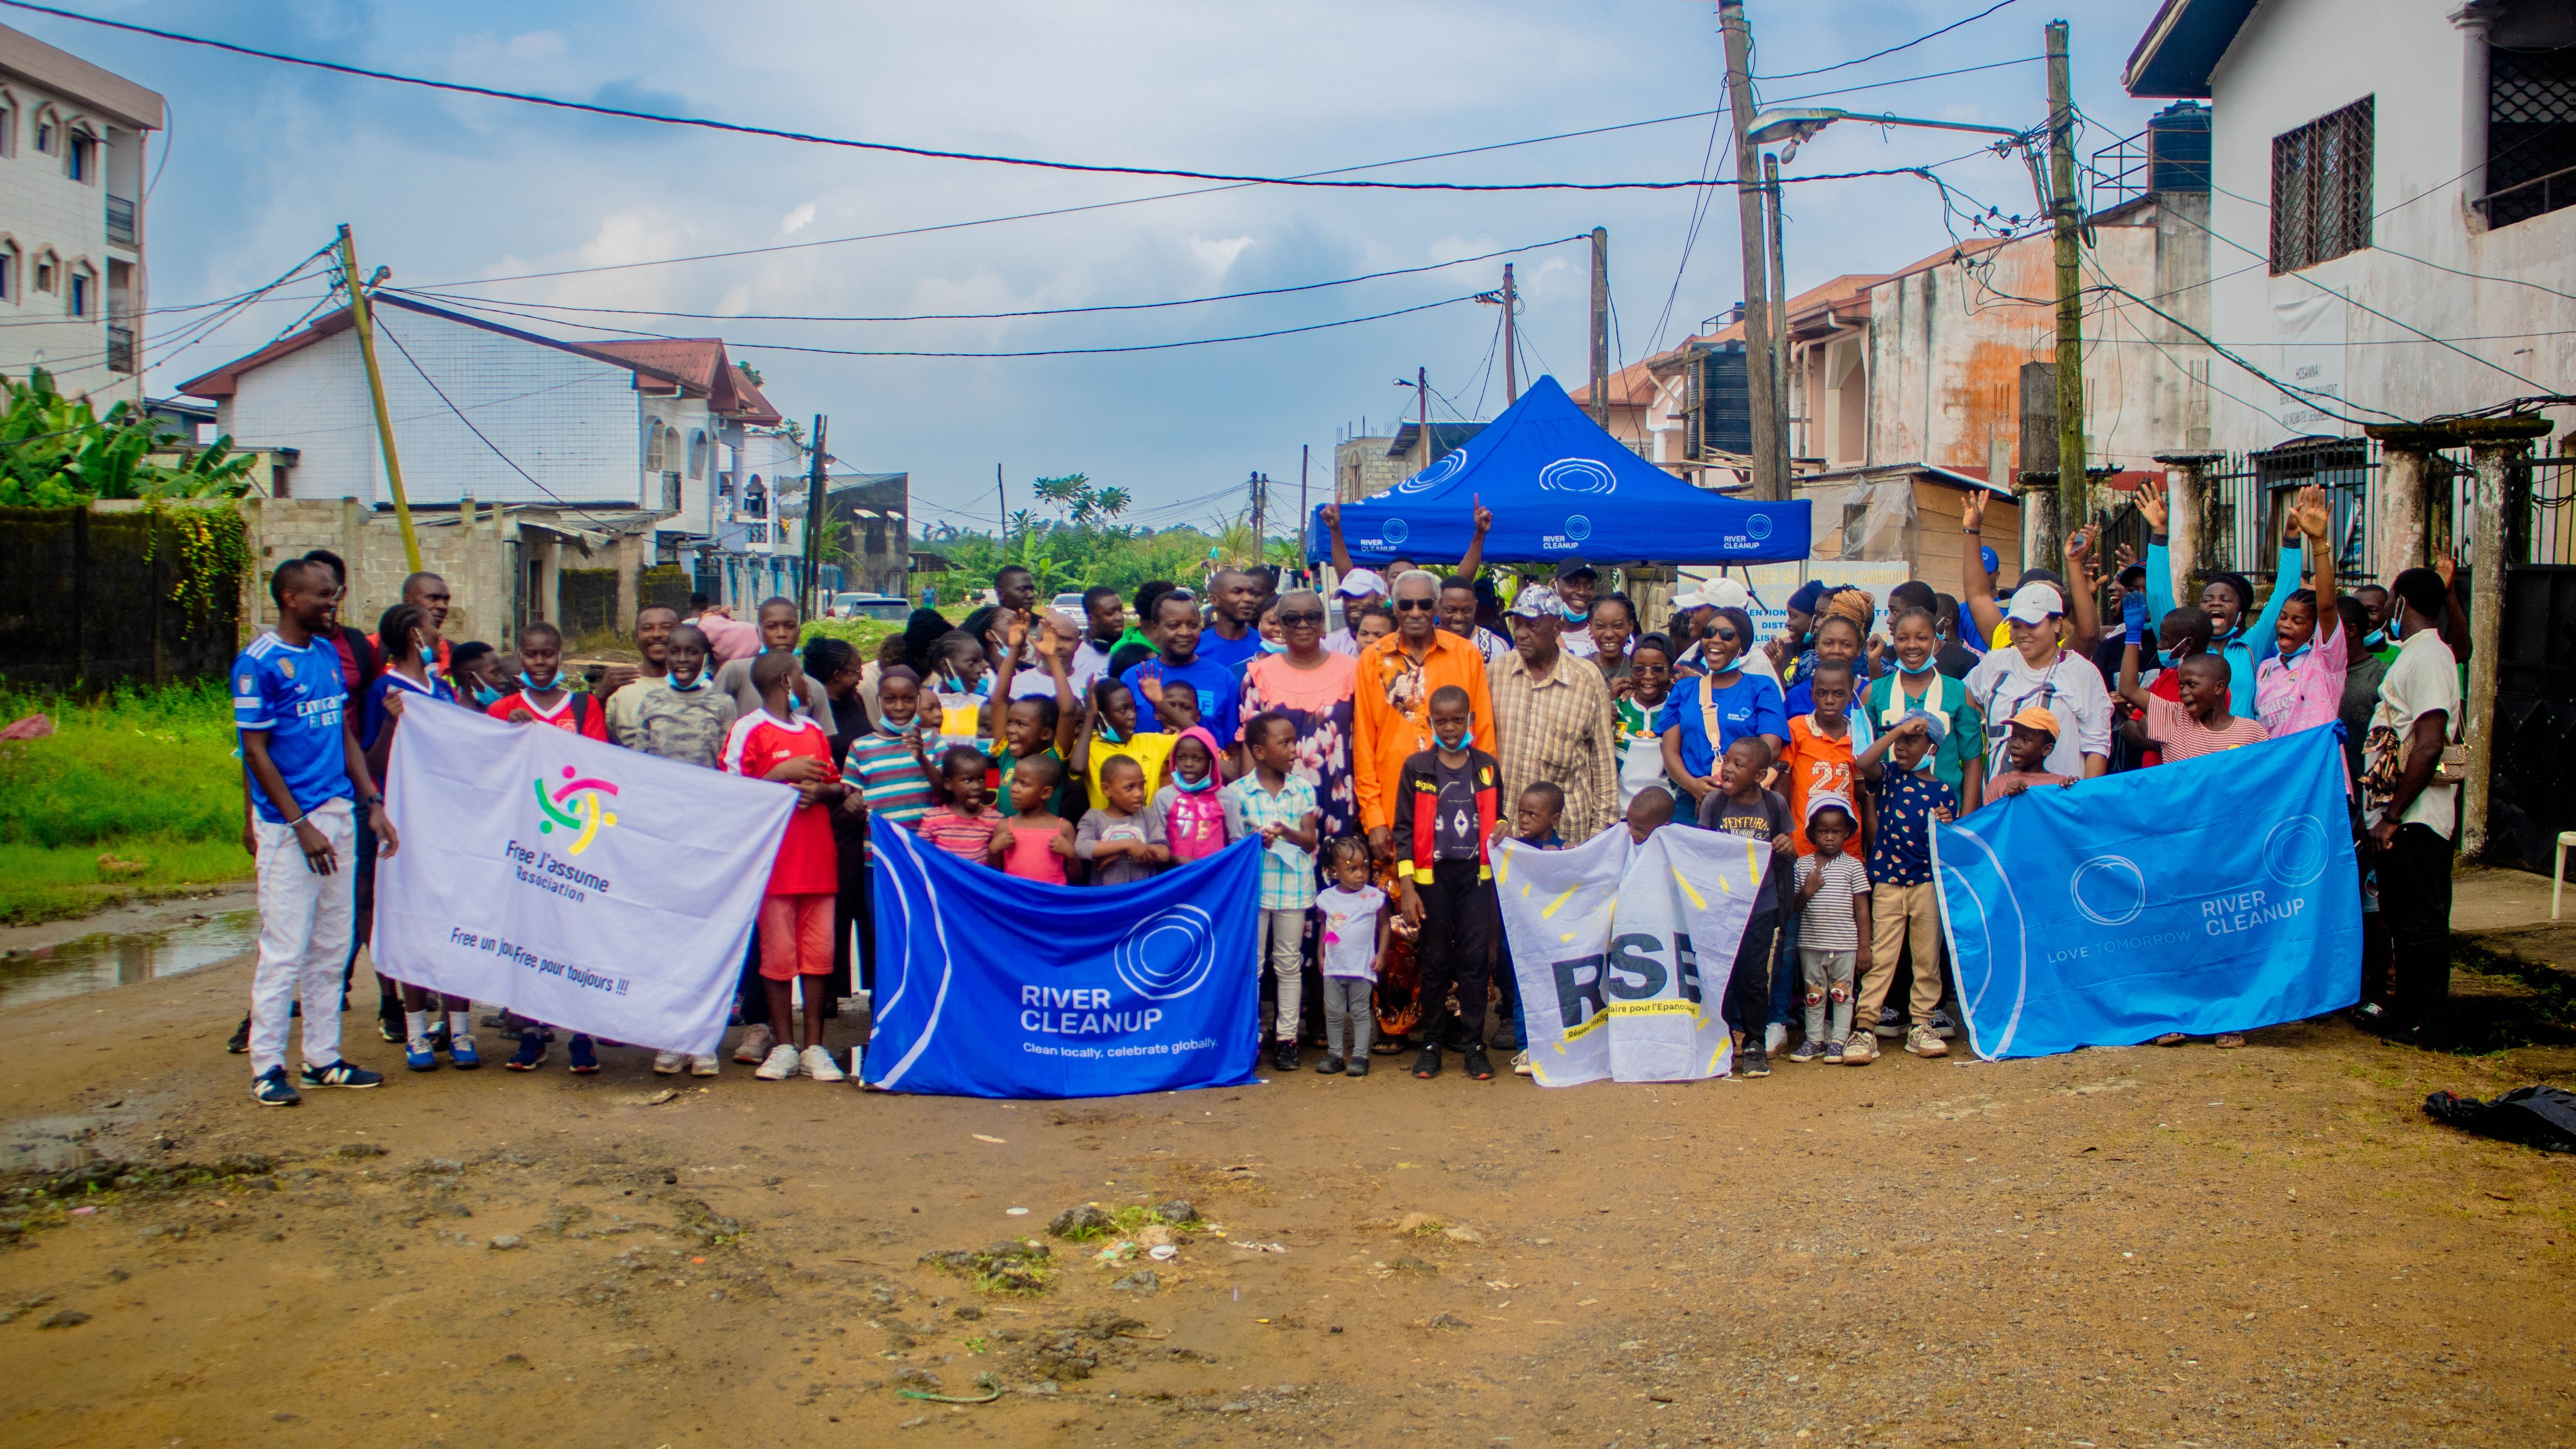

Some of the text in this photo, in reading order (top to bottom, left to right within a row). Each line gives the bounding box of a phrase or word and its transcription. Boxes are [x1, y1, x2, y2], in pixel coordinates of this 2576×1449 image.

[2295, 364, 2318, 381] HOSANNA
[1838, 570, 1852, 584] DU
[1855, 570, 1909, 584] CAMEROUN
[1808, 761, 1850, 800] 22
[1722, 816, 1768, 831] VENTURA
[505, 840, 610, 893] Free J'assume
[516, 865, 585, 903] Association
[2200, 890, 2266, 918] RIVER
[2205, 897, 2306, 937] CLEANUP
[450, 927, 478, 947] Free
[480, 937, 496, 952] un
[513, 946, 538, 967] Free
[538, 958, 565, 973] pour
[567, 964, 614, 991] toujours
[615, 978, 630, 996] !!!
[2047, 930, 2191, 964] LOVE TOMORROW
[1021, 985, 1111, 1009] RIVER
[1020, 1007, 1163, 1034] CLEANUP
[1568, 1025, 1590, 1038] Réseau
[1630, 1005, 1650, 1013] pour
[1023, 1037, 1218, 1060] Clean locally, celebrate globally.
